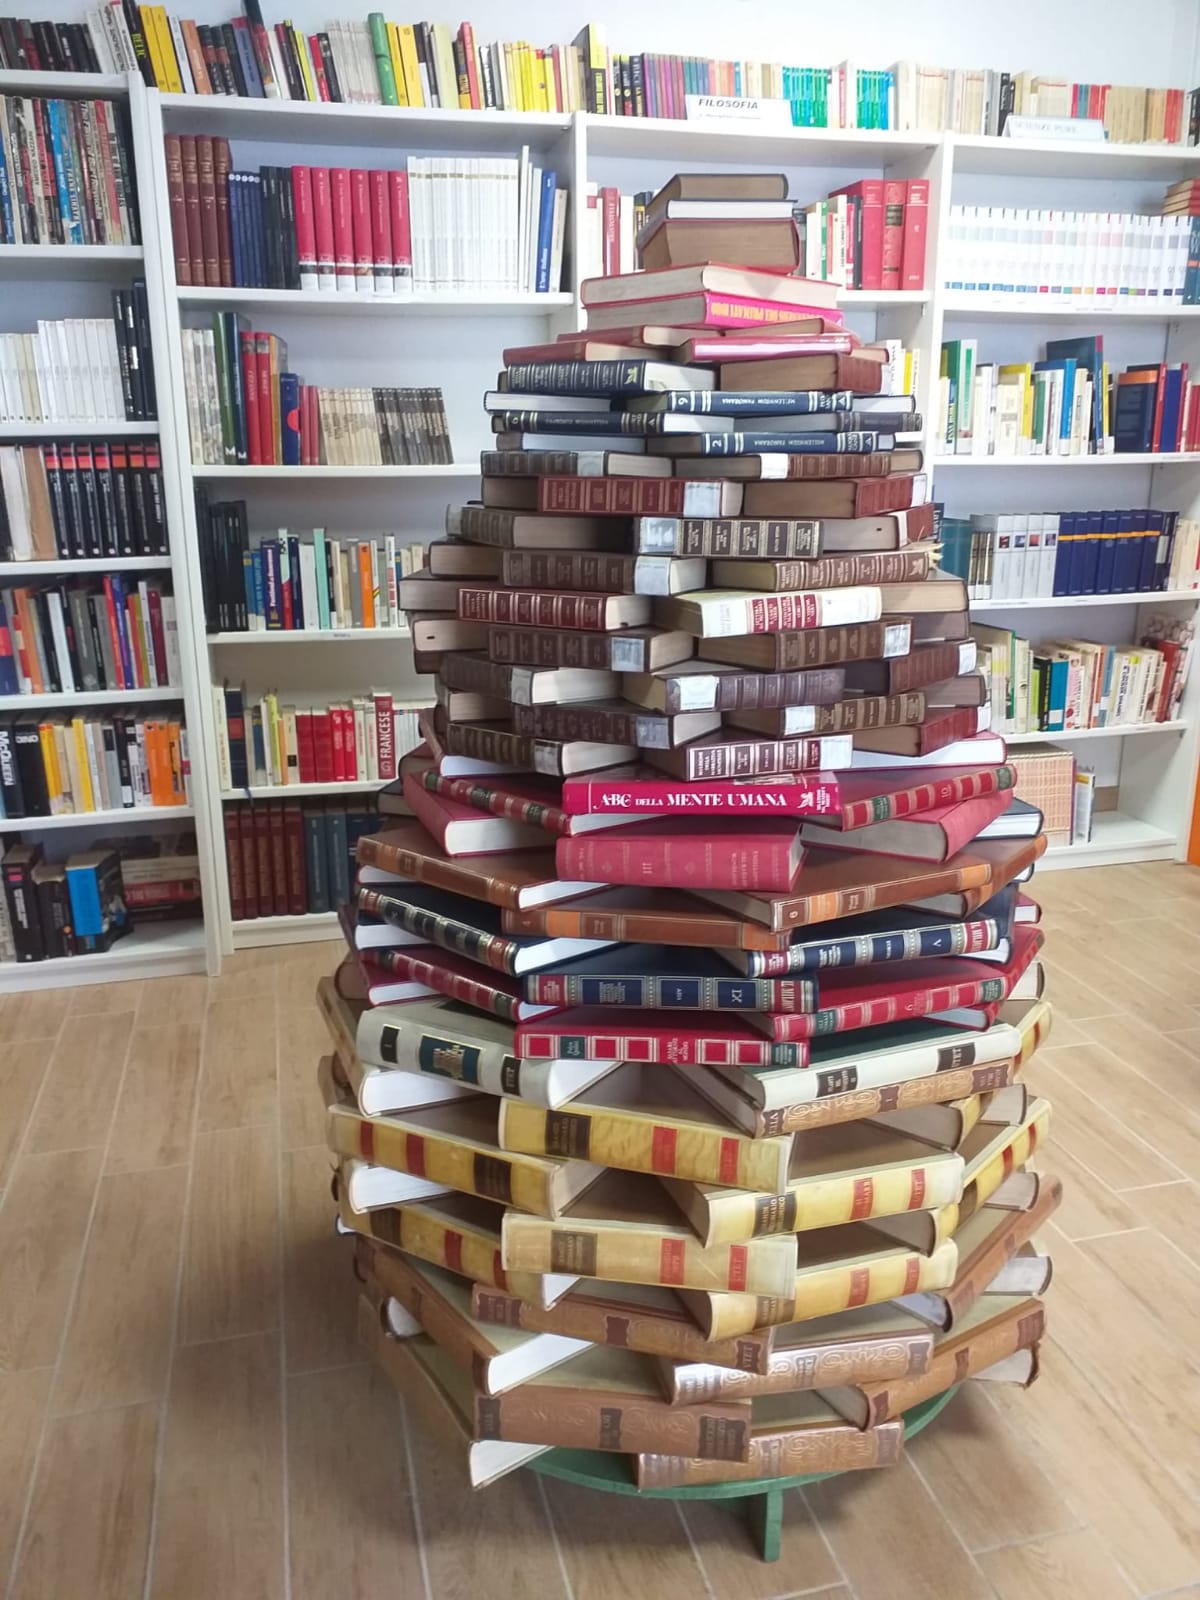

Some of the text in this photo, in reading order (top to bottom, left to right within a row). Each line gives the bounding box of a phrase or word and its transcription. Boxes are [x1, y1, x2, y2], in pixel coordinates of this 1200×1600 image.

[698, 98, 759, 109] FILOSOFIA
[379, 711, 392, 758] FRANCESE
[593, 793, 788, 809] ABC DELLA MENTE UMANA
[731, 989, 742, 1003] IX
